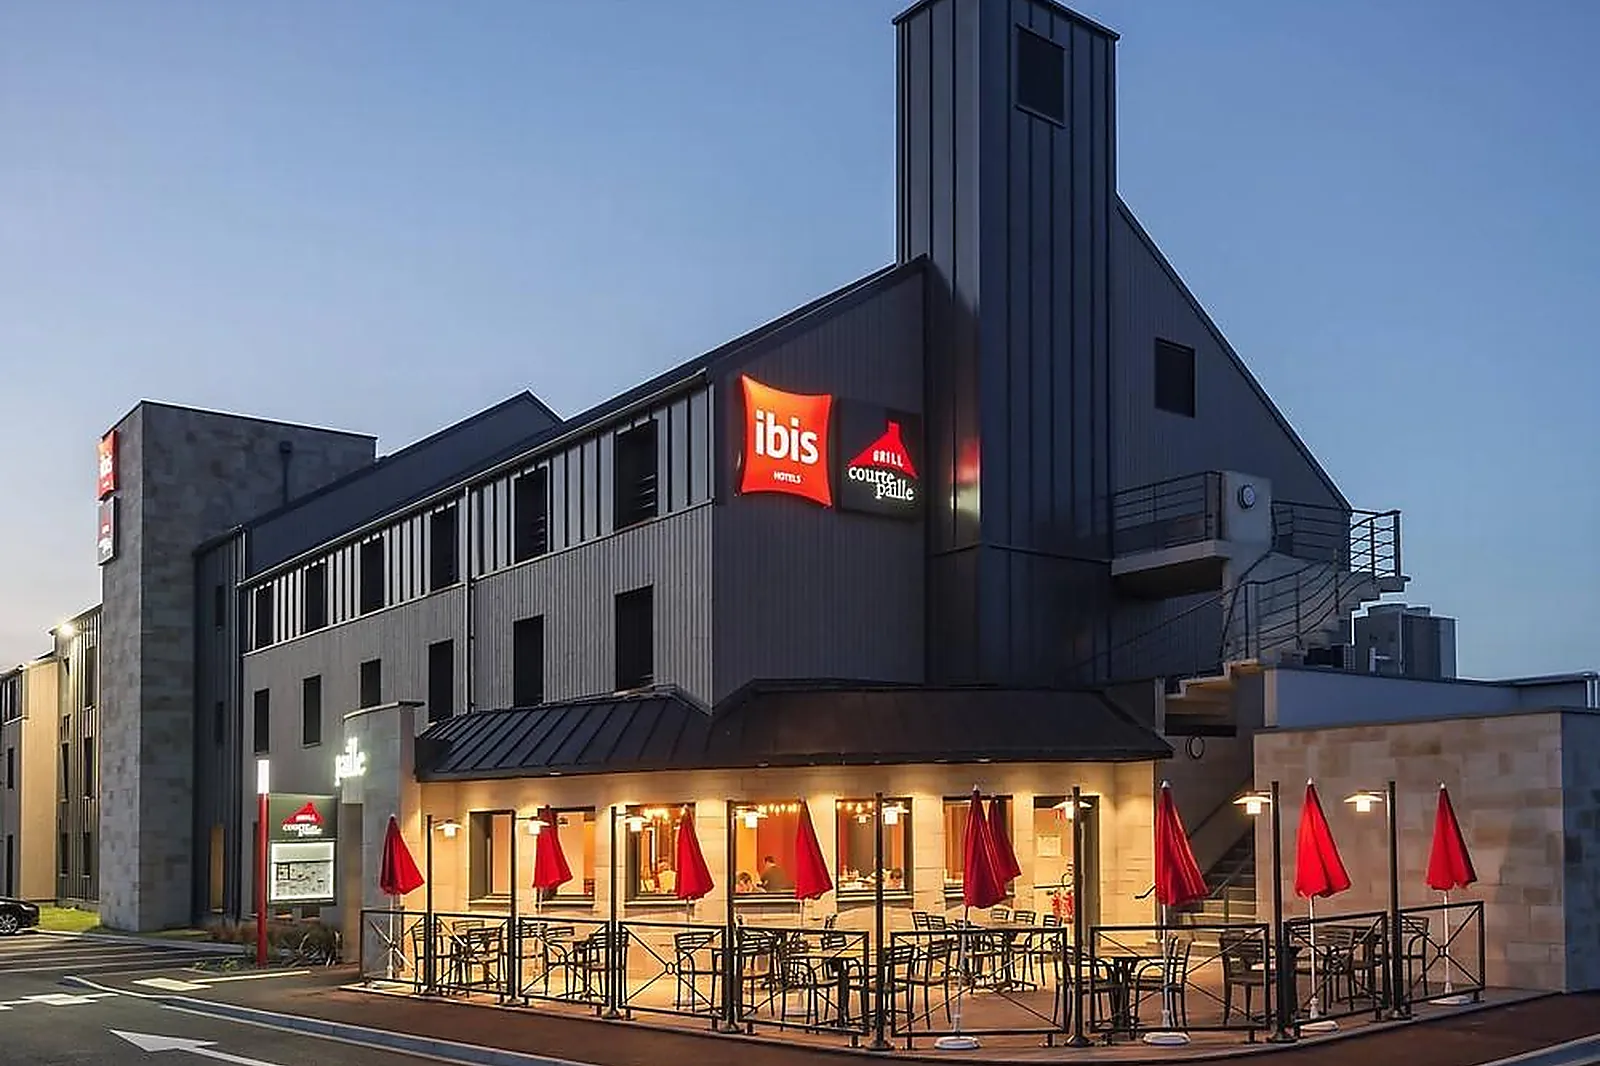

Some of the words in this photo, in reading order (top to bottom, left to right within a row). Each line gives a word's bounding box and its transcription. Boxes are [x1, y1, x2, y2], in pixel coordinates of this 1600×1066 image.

[756, 410, 818, 464] ibis
[873, 450, 903, 467] GRILL
[774, 471, 801, 484] HOTELS
[848, 467, 895, 485] courte
[875, 480, 914, 501] paille
